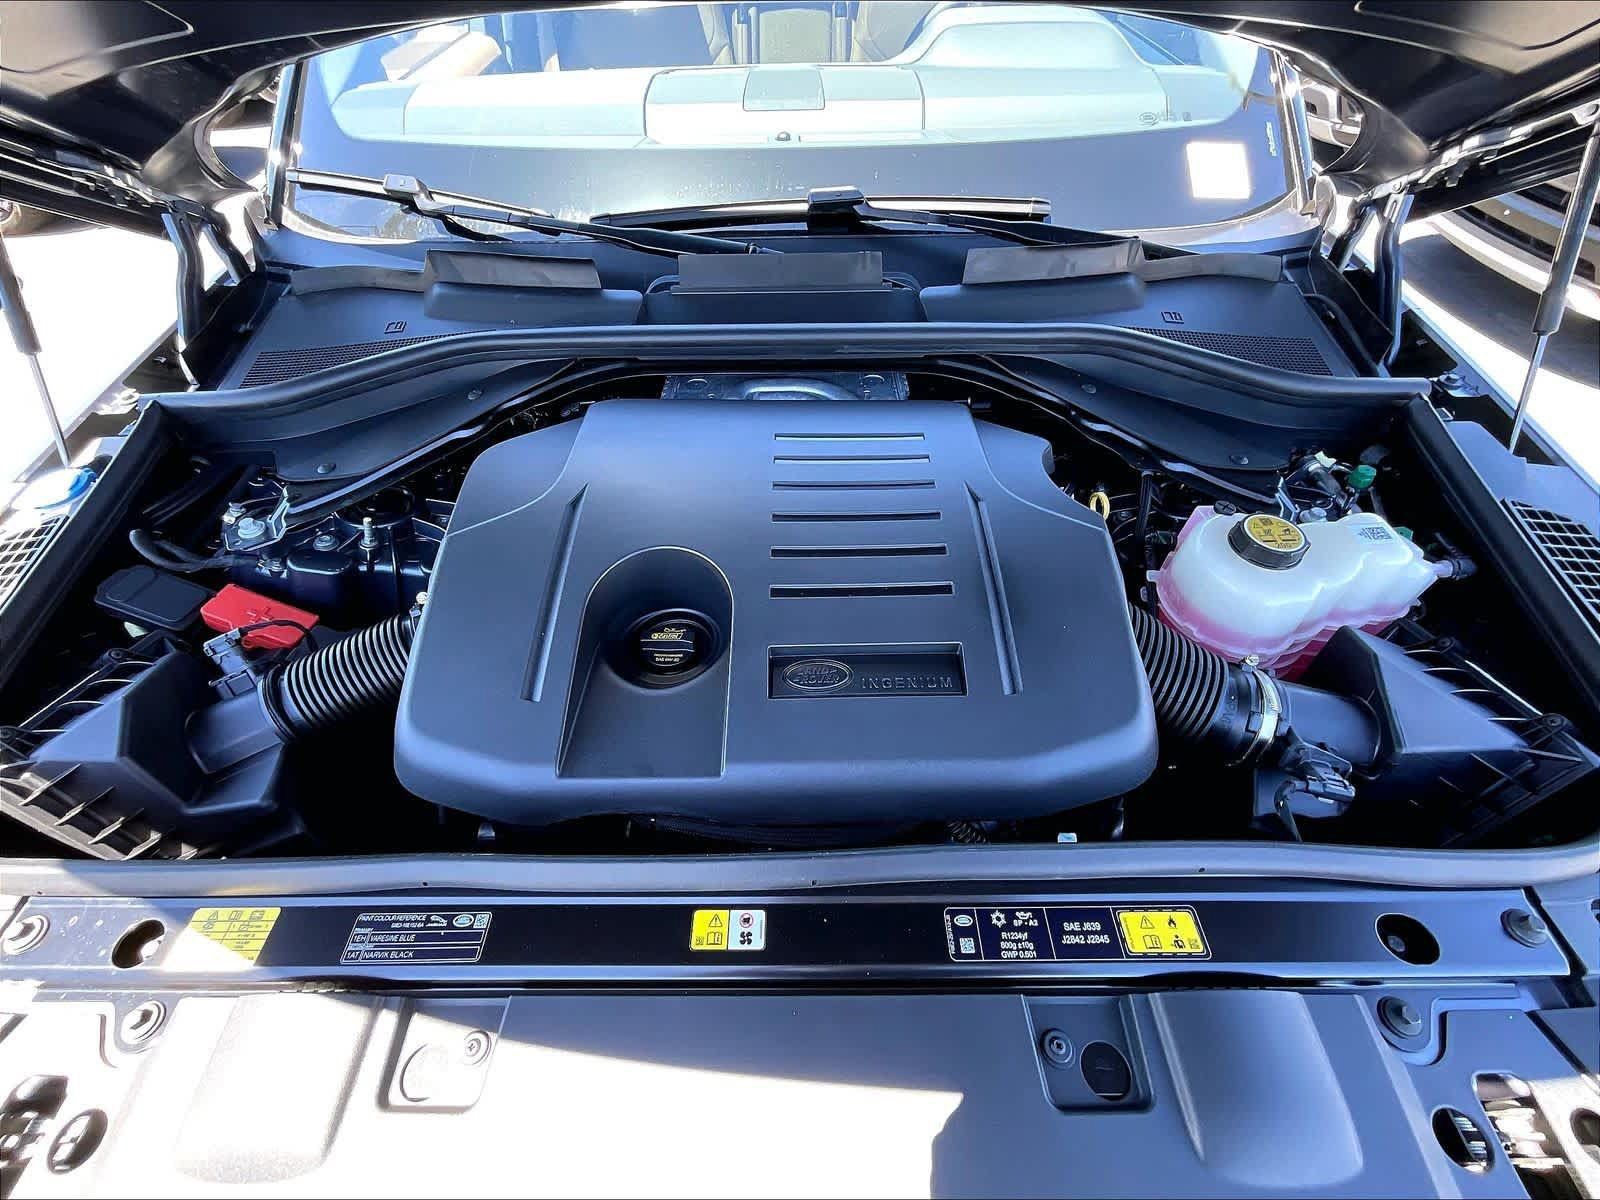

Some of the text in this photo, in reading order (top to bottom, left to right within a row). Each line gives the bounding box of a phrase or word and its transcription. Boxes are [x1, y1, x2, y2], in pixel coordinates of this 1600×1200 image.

[861, 676, 953, 689] INGENIUM
[1063, 921, 1081, 931] SAE
[370, 934, 399, 942] VARESINE
[399, 933, 416, 942] BLUE
[1001, 931, 1028, 941] R1234yf
[1061, 934, 1110, 945] J2842 J2845
[347, 950, 414, 960] 1AT NARVIK BLACK
[1001, 950, 1018, 959] GWP
